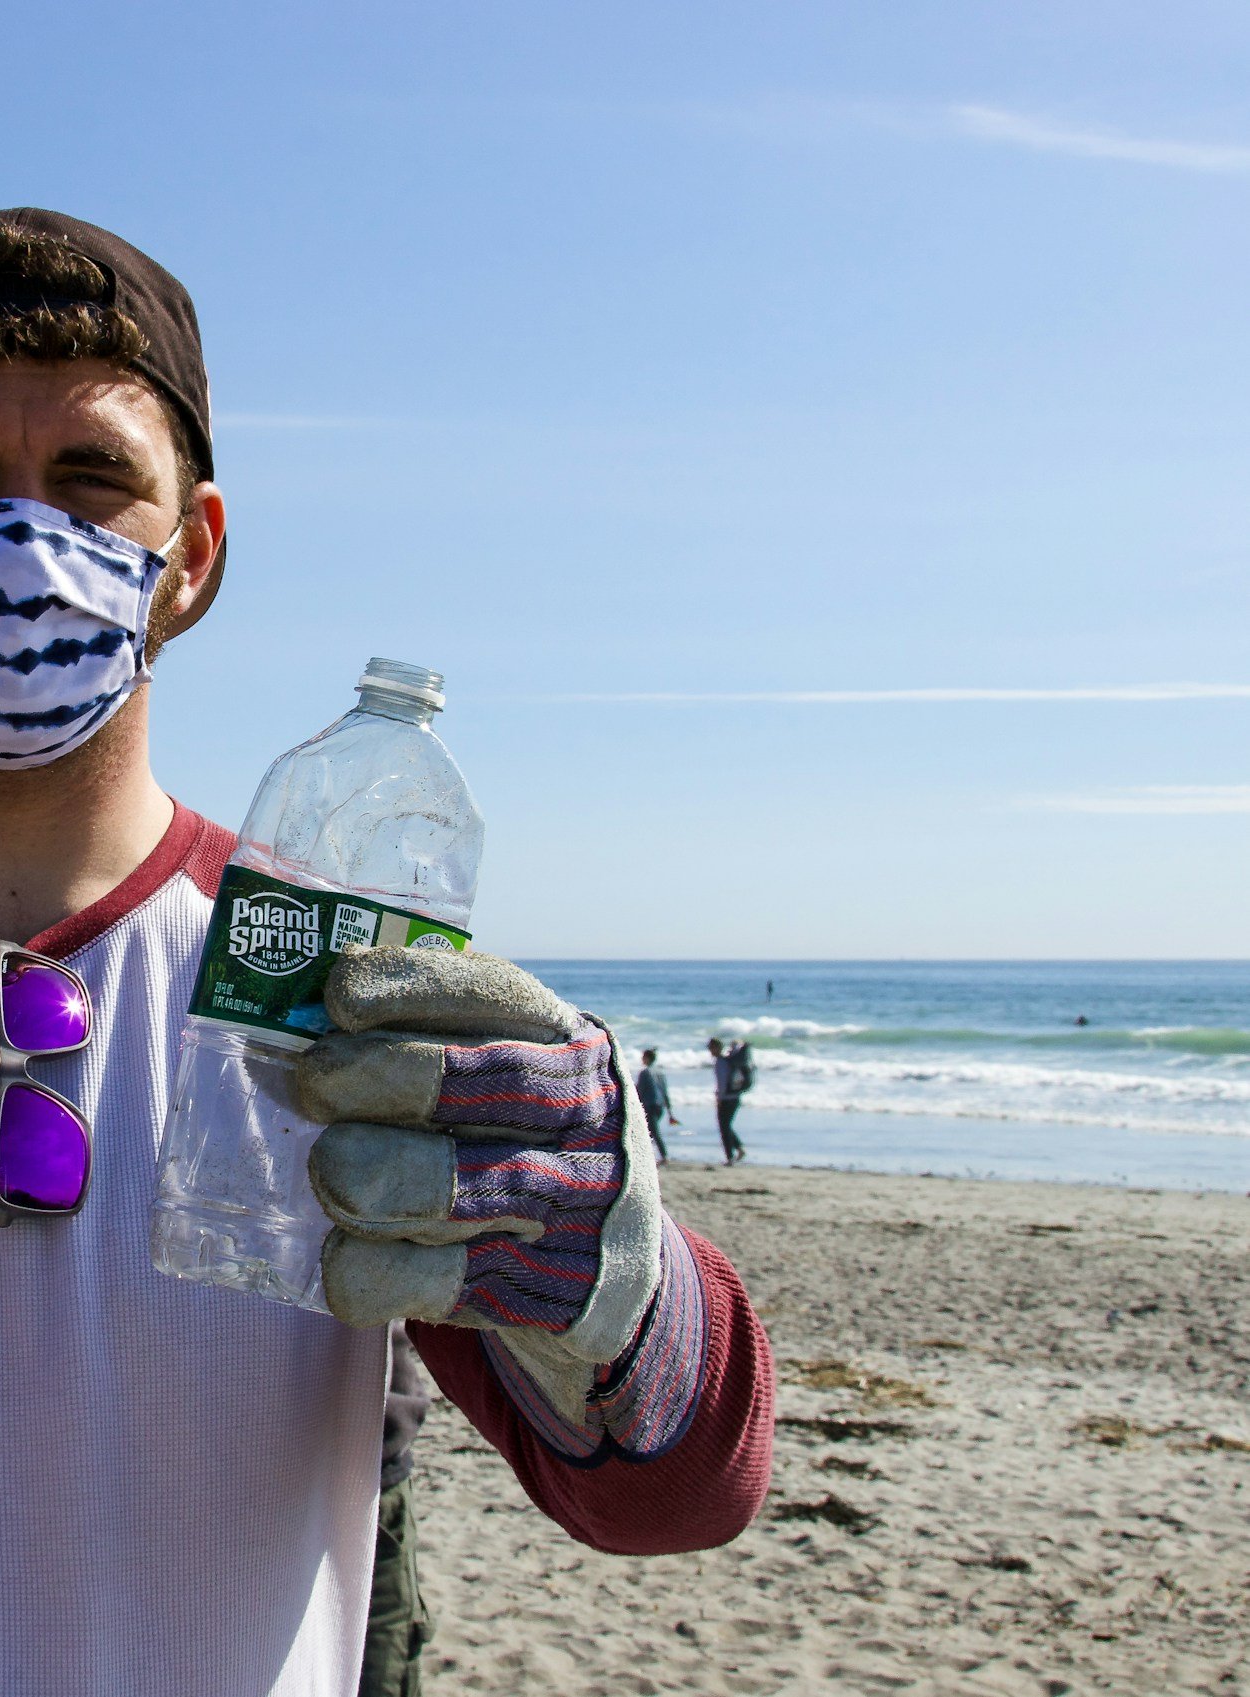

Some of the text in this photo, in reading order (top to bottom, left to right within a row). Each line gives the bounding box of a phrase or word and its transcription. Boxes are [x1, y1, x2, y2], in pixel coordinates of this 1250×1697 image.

[230, 898, 320, 931] Poland
[339, 907, 362, 923] 100%
[336, 931, 364, 944] SPRING
[338, 922, 370, 939] NATURAL
[228, 926, 319, 957] Spring
[247, 954, 268, 968] BORN
[280, 955, 304, 969] MAINE
[262, 950, 286, 960] 1845
[215, 982, 234, 995] 20 FL OZ
